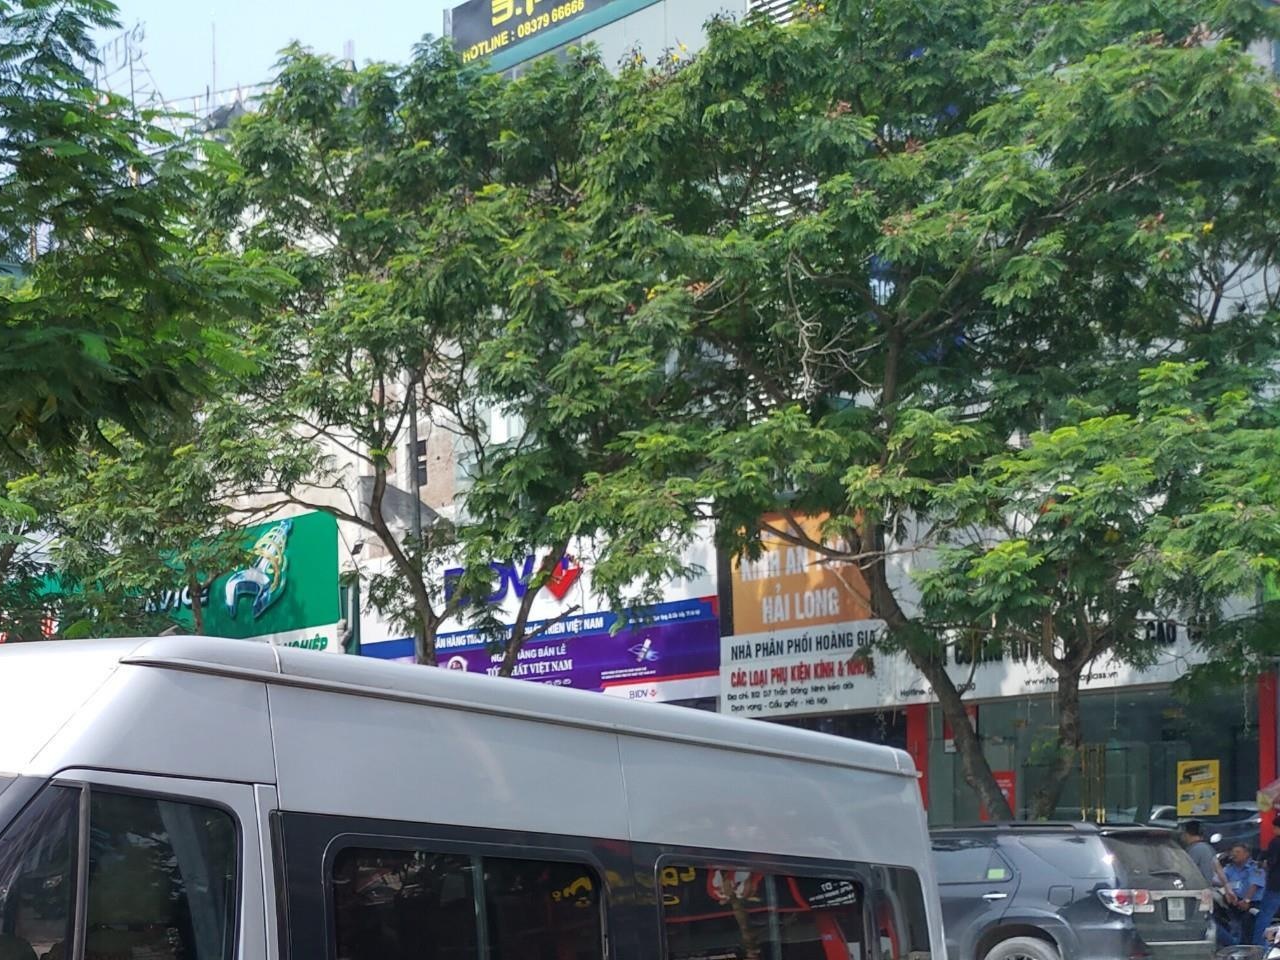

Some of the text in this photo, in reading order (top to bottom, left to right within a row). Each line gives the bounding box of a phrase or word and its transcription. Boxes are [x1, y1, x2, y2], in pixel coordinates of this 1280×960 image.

[463, 31, 509, 63] HOTLINE
[517, 16, 550, 38] 08379
[551, 1, 586, 23] 66666
[762, 583, 840, 624] HẢI LONG
[584, 616, 604, 630] NAM
[538, 645, 555, 657] BÁN
[731, 640, 752, 660] NHÀ
[755, 637, 784, 658] PHÂN
[787, 632, 812, 655] PHỐI
[816, 630, 853, 651] HOÀNG
[529, 660, 550, 675] VIỆT
[551, 658, 574, 673] NAM
[731, 667, 747, 688] CÁC
[749, 668, 768, 689] LOẠI
[629, 689, 648, 699] BIDV
